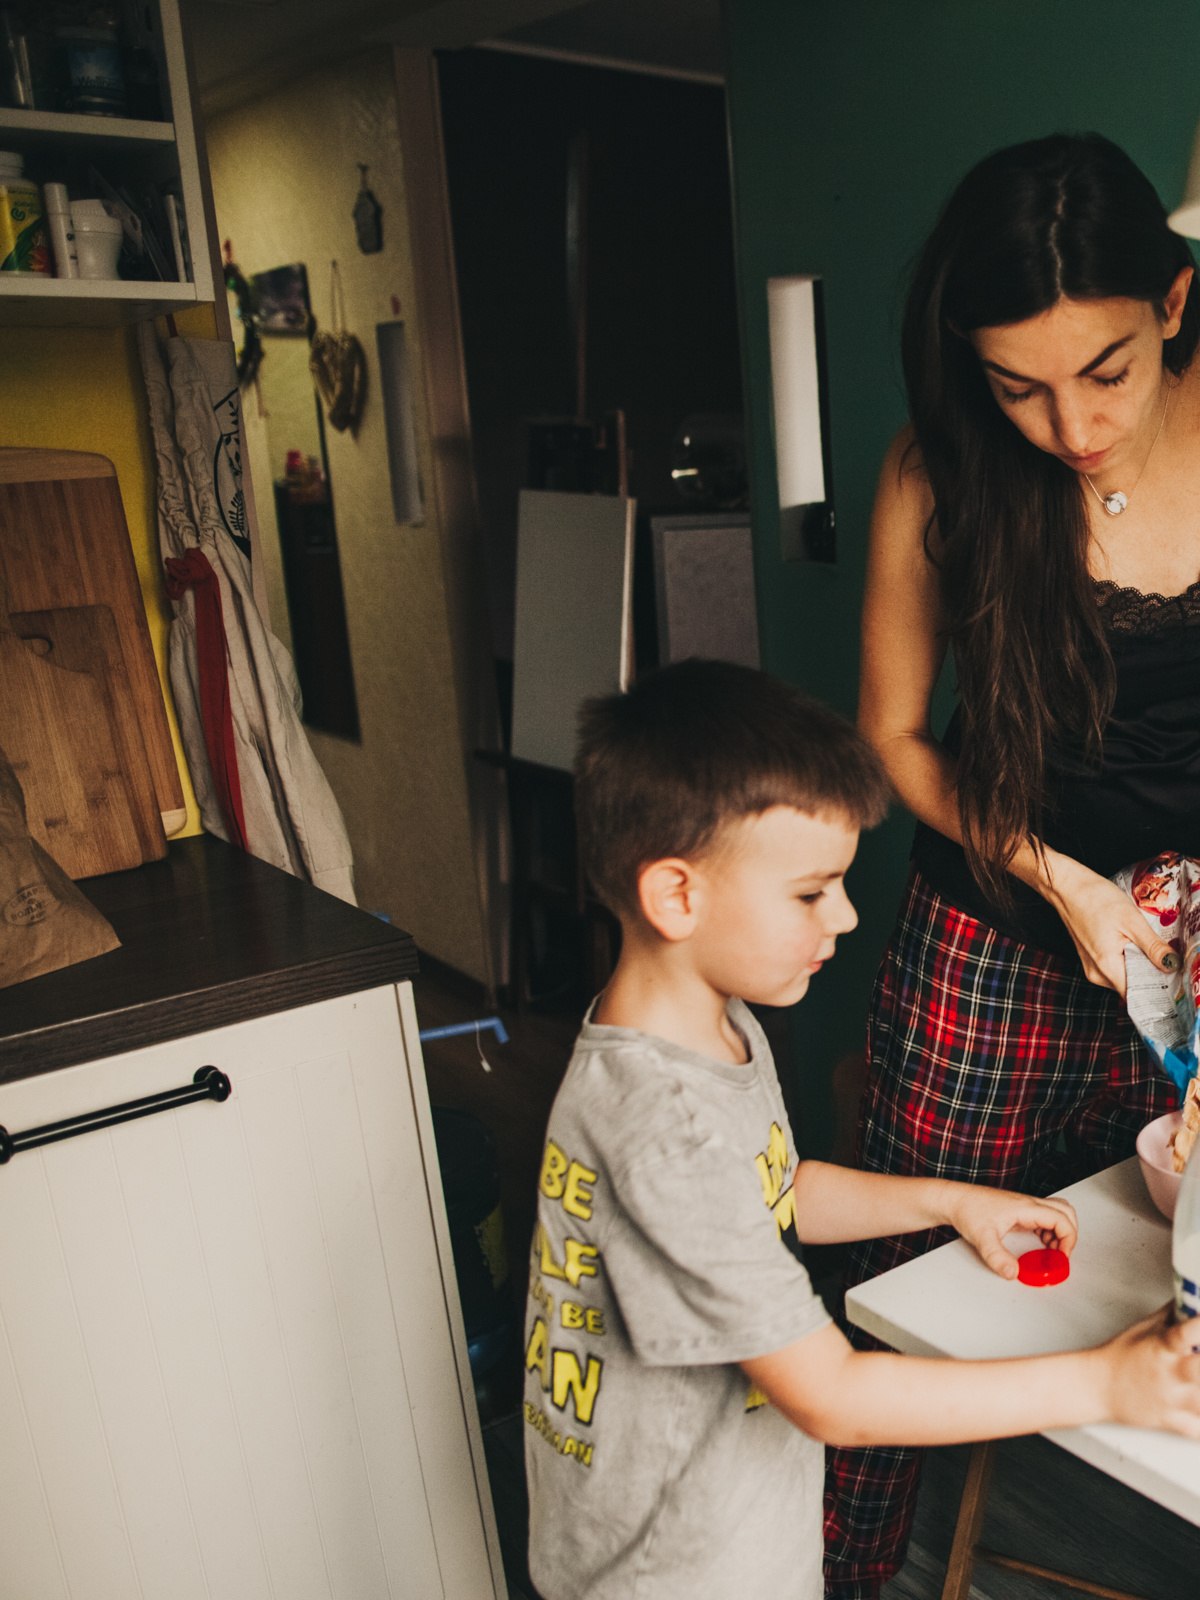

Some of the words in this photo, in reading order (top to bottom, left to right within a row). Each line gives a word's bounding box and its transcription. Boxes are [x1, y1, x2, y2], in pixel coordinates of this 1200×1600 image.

[539, 1138, 597, 1222] BE
[531, 1221, 598, 1289] LF
[561, 1300, 606, 1336] BE
